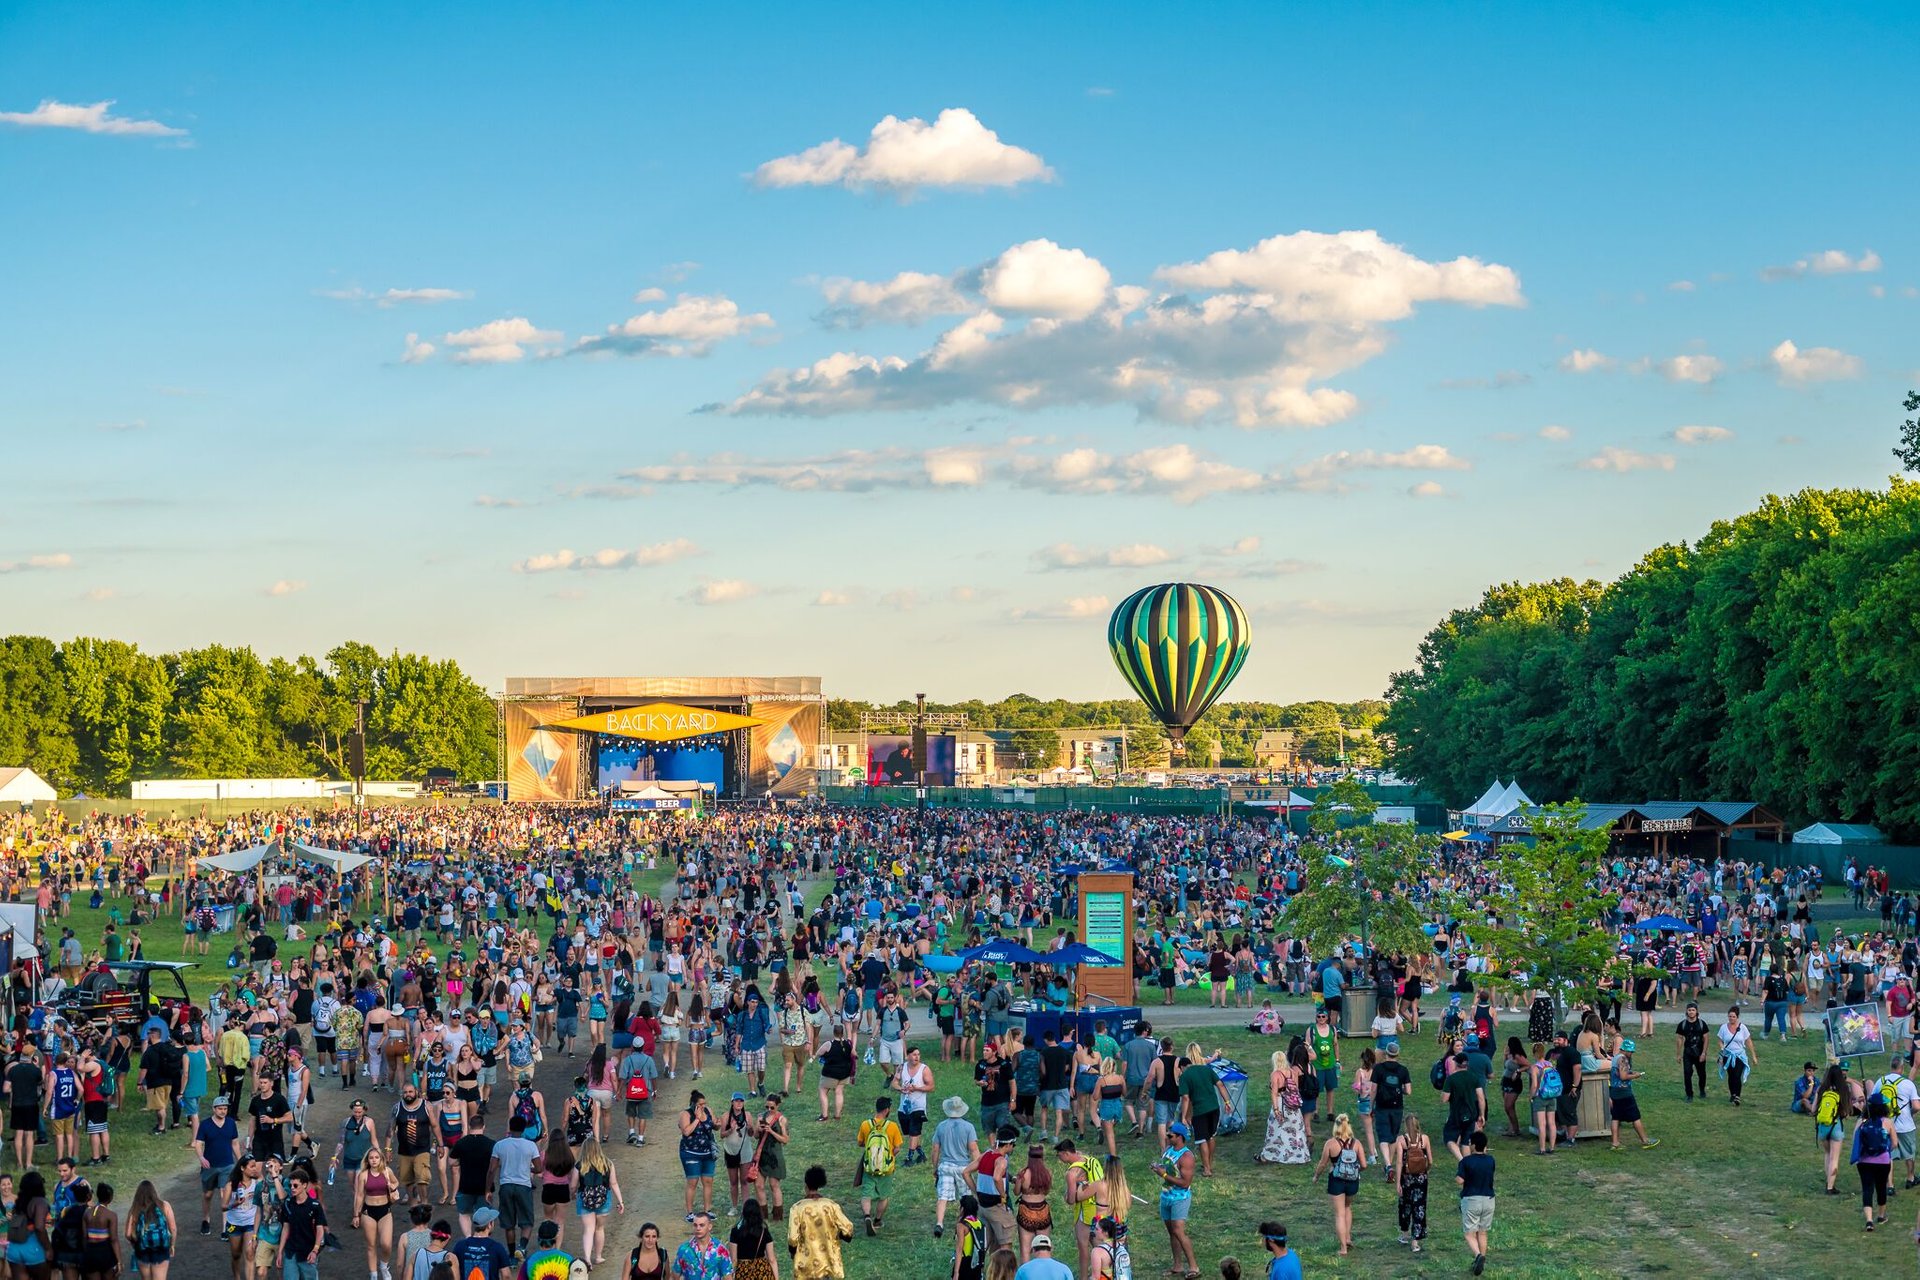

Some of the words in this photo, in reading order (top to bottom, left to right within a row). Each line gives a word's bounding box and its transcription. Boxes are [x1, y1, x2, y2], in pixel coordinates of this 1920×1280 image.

[607, 713, 717, 731] BACKYARD
[1244, 789, 1272, 800] VIP
[655, 799, 680, 808] BEER
[61, 1084, 73, 1098] 21
